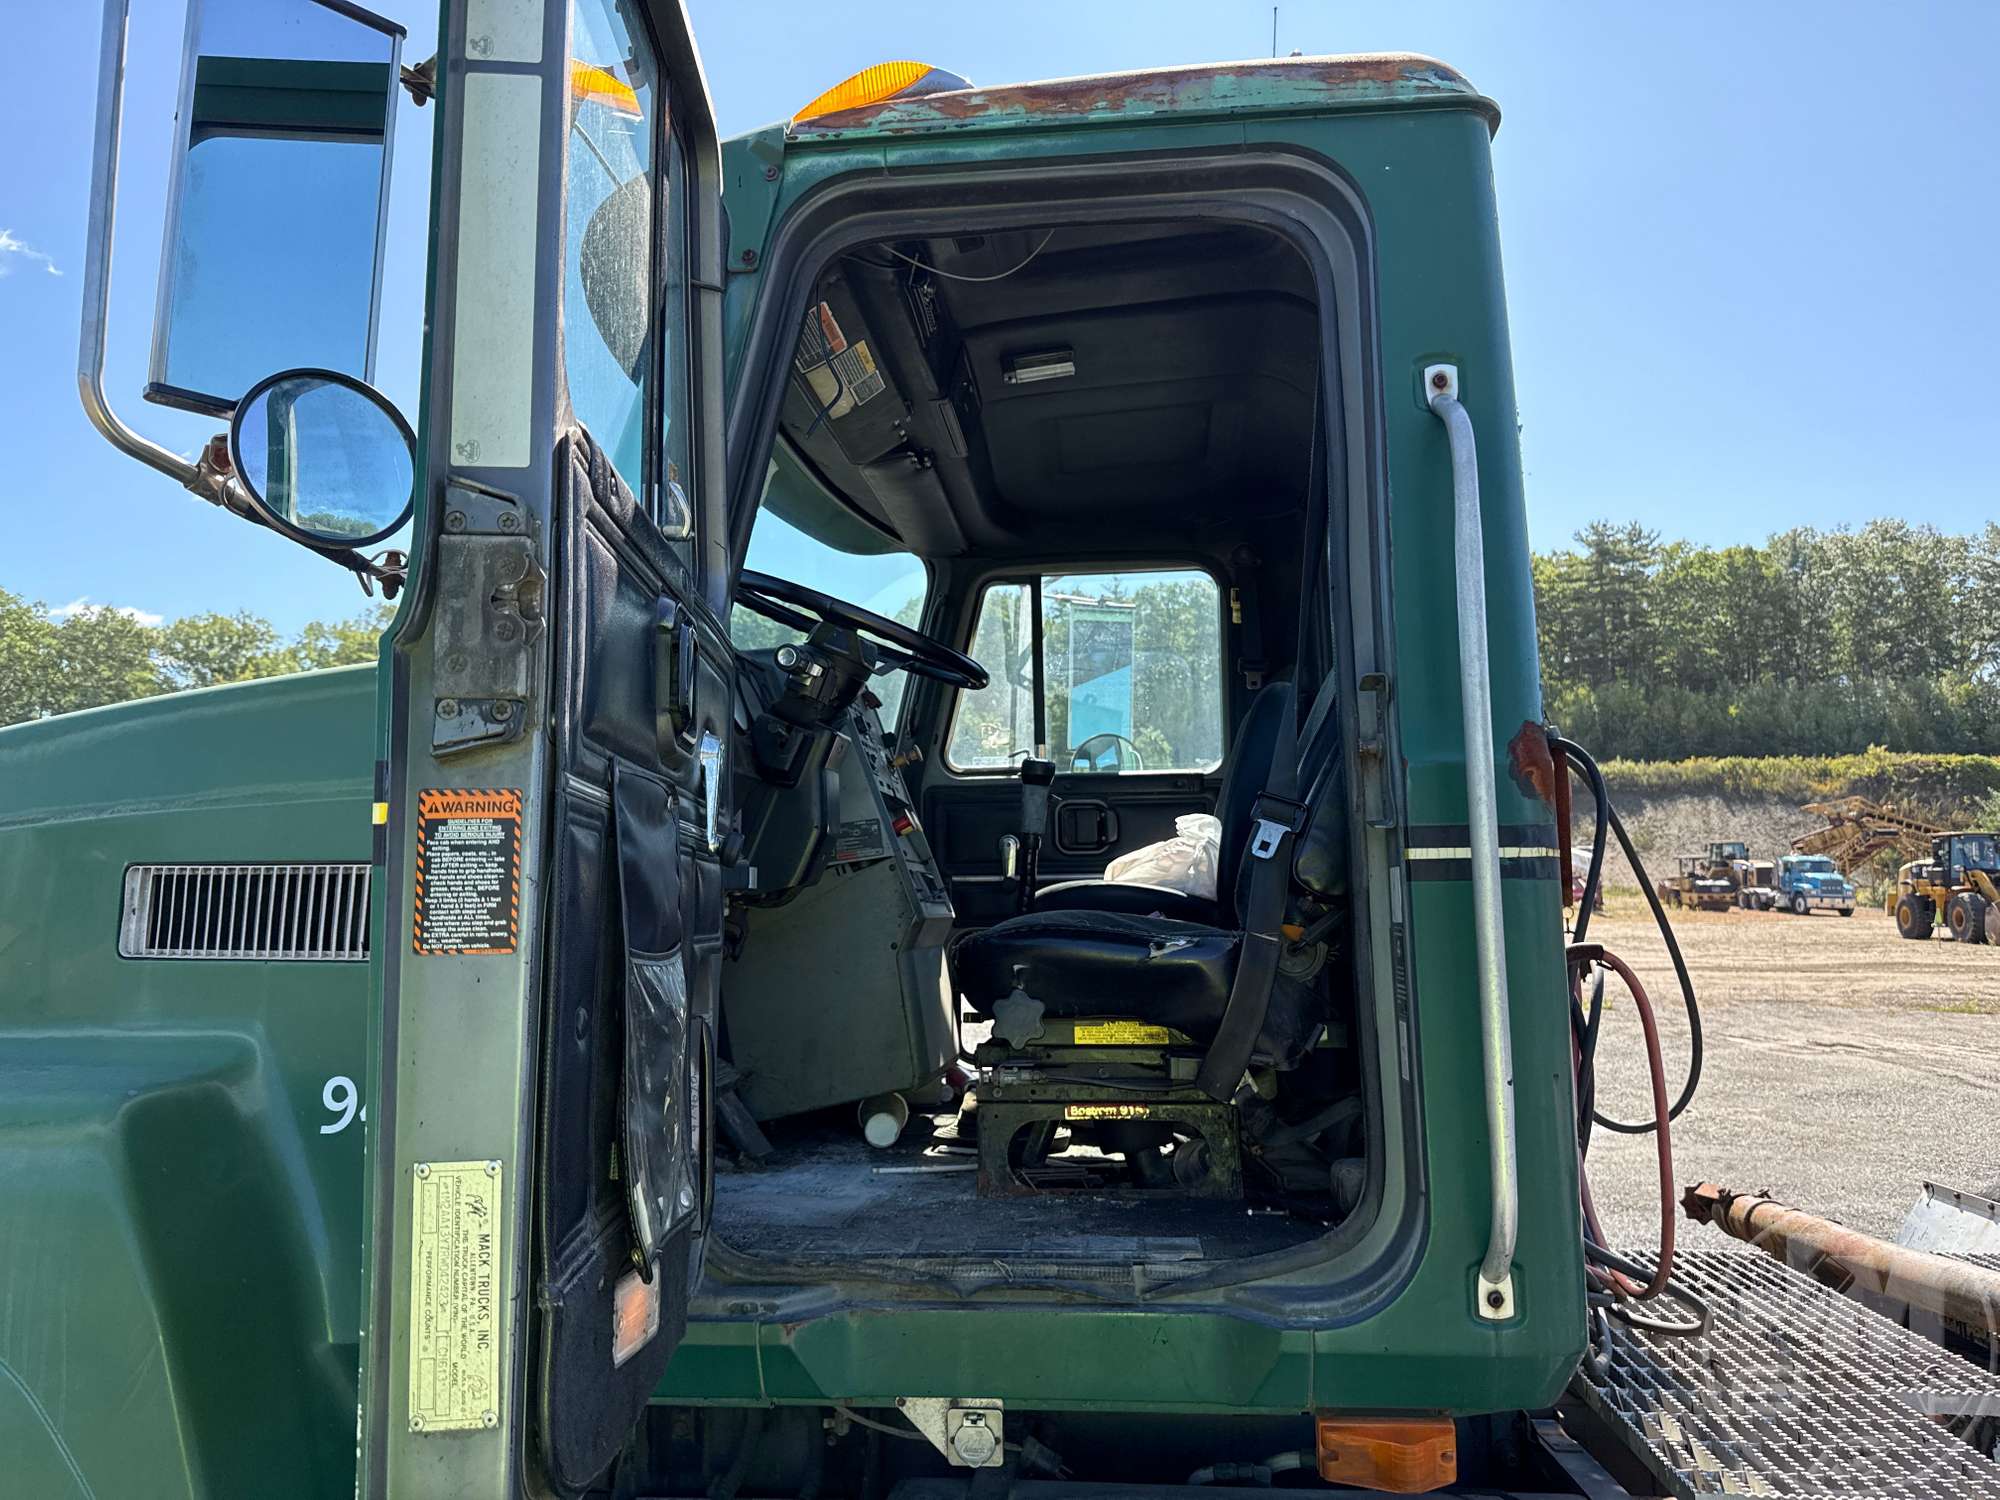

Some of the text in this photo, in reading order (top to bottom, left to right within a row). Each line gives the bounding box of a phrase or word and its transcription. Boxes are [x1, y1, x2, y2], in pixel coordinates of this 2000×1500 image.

[441, 802, 513, 813] WARNING
[320, 1076, 367, 1134] 9
[461, 1304, 467, 1314] OF
[476, 1234, 490, 1354] MACK TRUCKS, INC.
